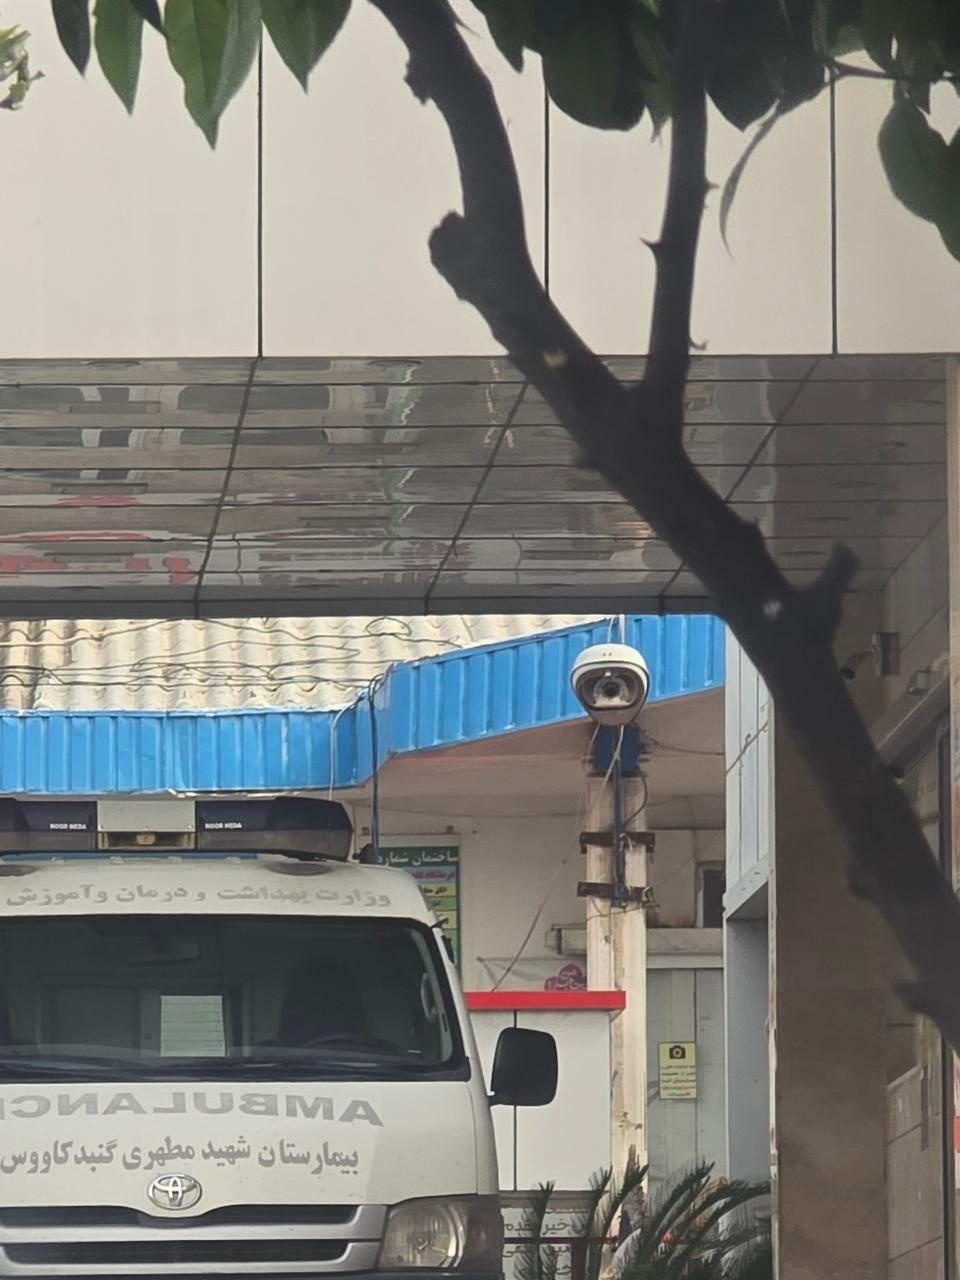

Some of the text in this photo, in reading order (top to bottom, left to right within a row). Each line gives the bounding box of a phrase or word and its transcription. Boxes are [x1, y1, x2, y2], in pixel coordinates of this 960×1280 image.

[6, 884, 94, 907] آموزش
[94, 887, 107, 903] و
[115, 884, 189, 902] درمان
[196, 889, 206, 902] و
[217, 886, 310, 904] بهداشت
[315, 887, 391, 907] وزارت
[122, 1136, 196, 1170] مطهری
[201, 1135, 251, 1167] شهید
[257, 1139, 359, 1175] بیمارستان
